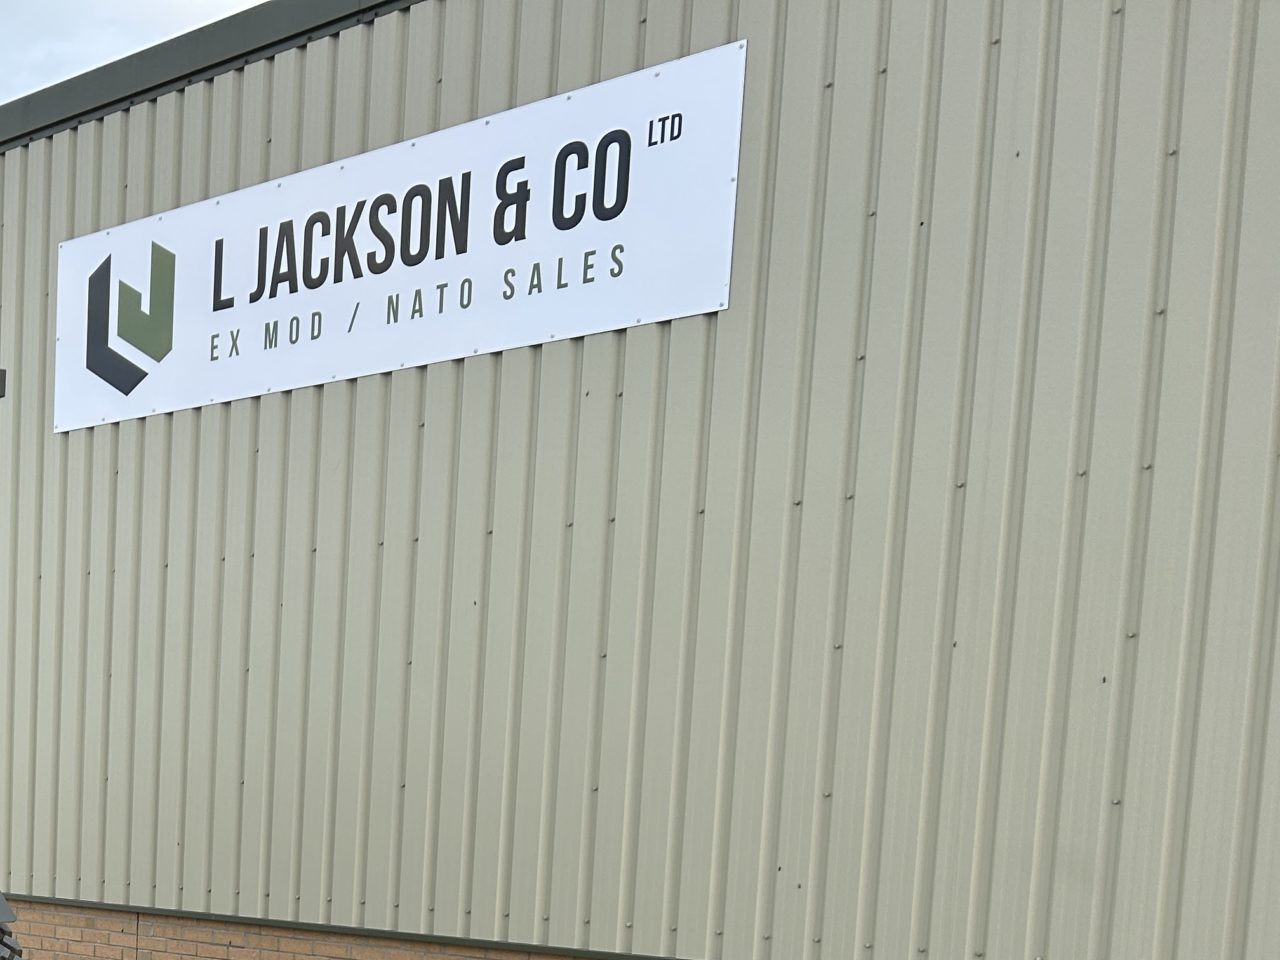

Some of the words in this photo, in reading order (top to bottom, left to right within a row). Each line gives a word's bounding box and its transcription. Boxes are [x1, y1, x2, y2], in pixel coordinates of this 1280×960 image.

[212, 237, 235, 313] L
[248, 170, 472, 305] JACKSON
[492, 155, 531, 246] &
[551, 128, 632, 232] CO
[647, 112, 683, 148] LTD
[209, 328, 242, 362] EX
[263, 311, 322, 350] MOD
[347, 302, 361, 334] /
[386, 277, 473, 325] NATO
[502, 243, 626, 301] SALES
